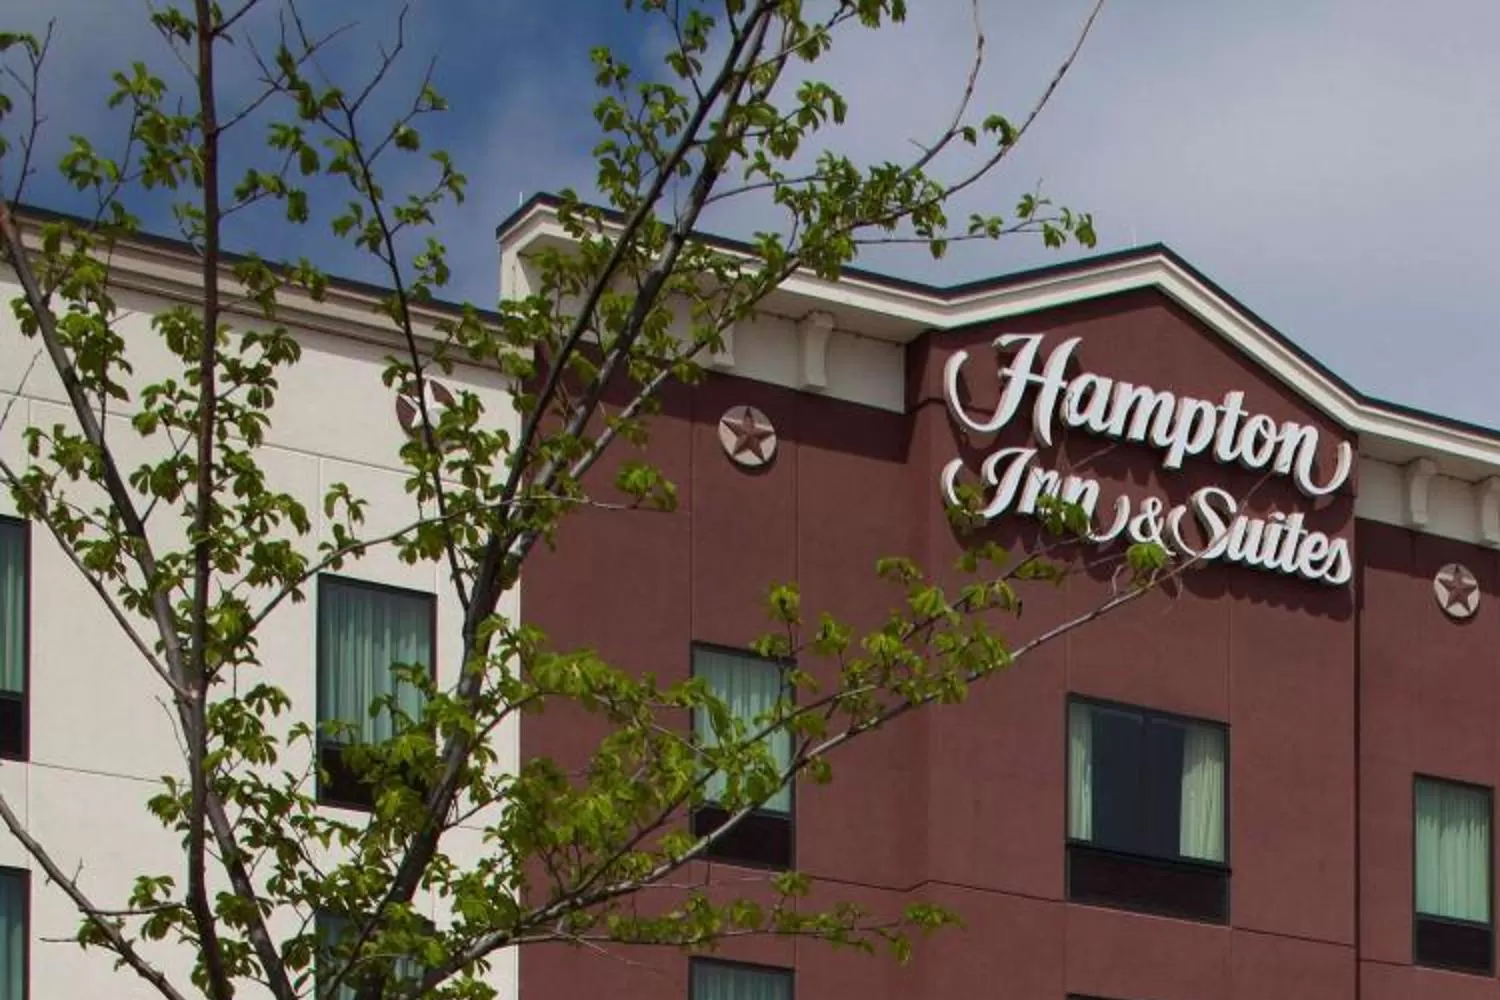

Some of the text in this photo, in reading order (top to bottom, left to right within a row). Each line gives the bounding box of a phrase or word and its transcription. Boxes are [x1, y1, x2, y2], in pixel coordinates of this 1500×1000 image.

[944, 333, 1353, 496] Hampton
[941, 447, 1353, 585] Inn & Suites
